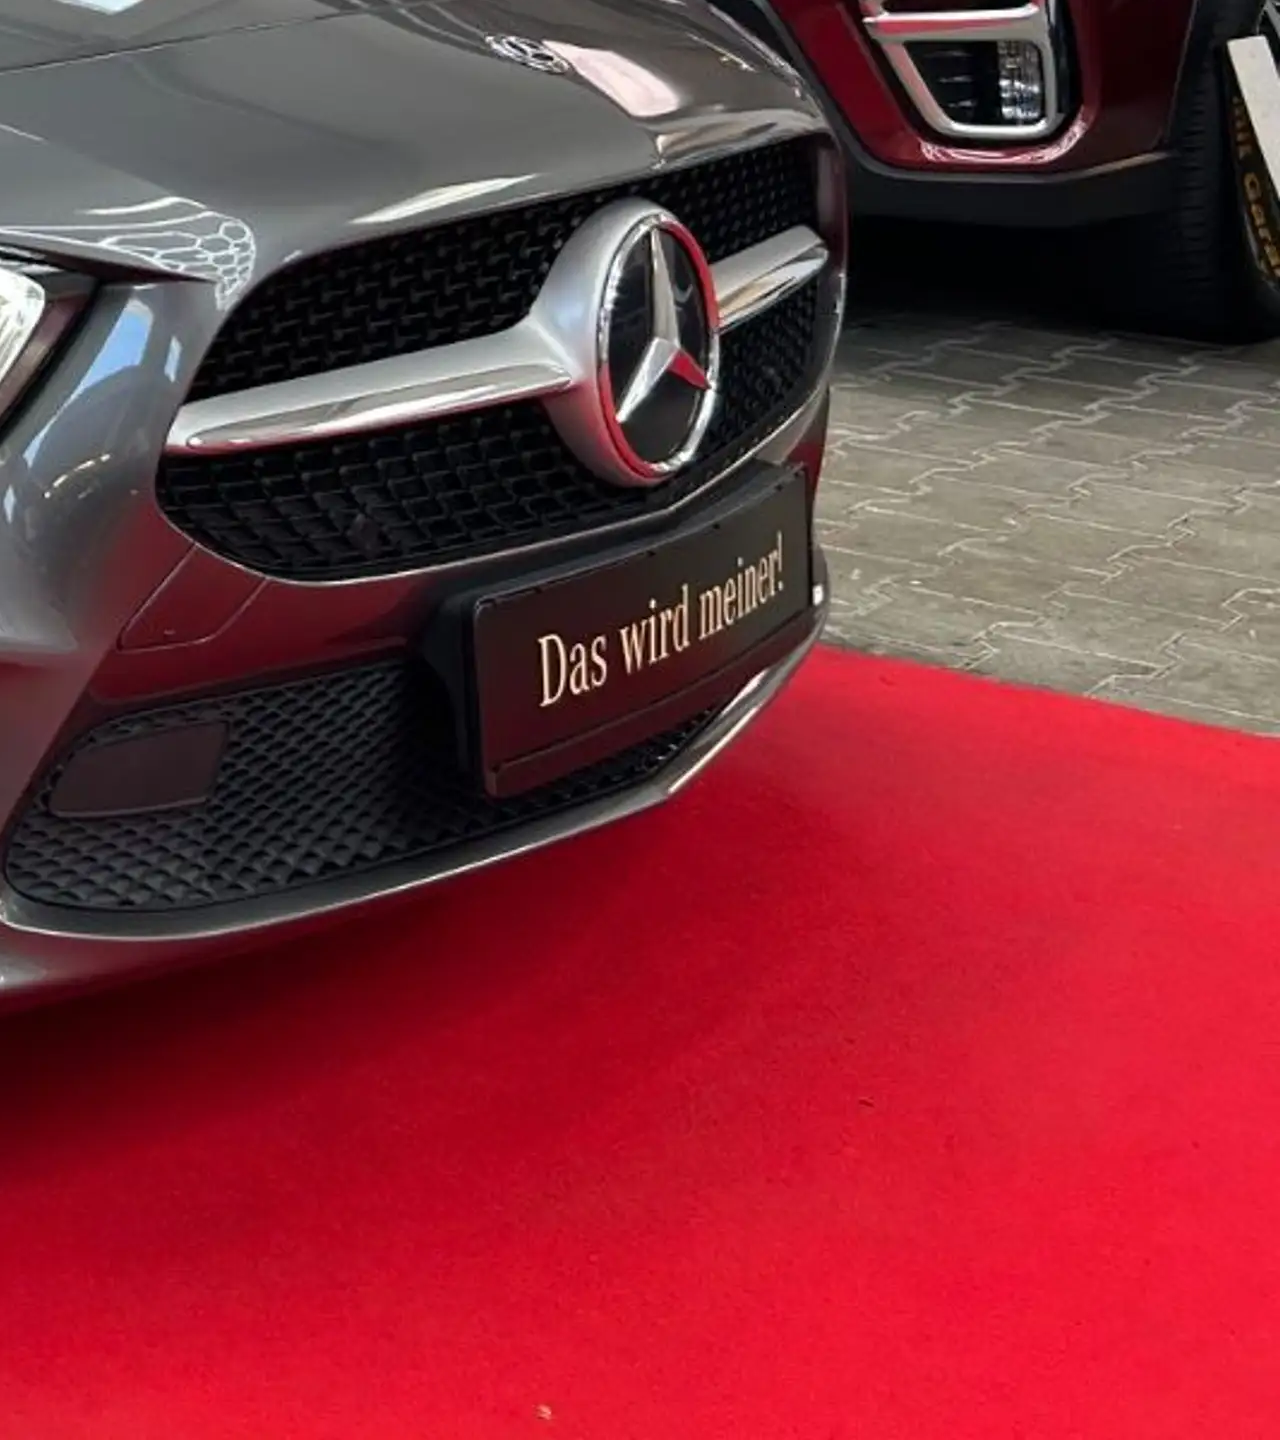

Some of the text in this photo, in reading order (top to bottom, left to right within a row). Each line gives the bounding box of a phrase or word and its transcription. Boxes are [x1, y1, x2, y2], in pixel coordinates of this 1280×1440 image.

[537, 530, 785, 708] Das wird meiner!
